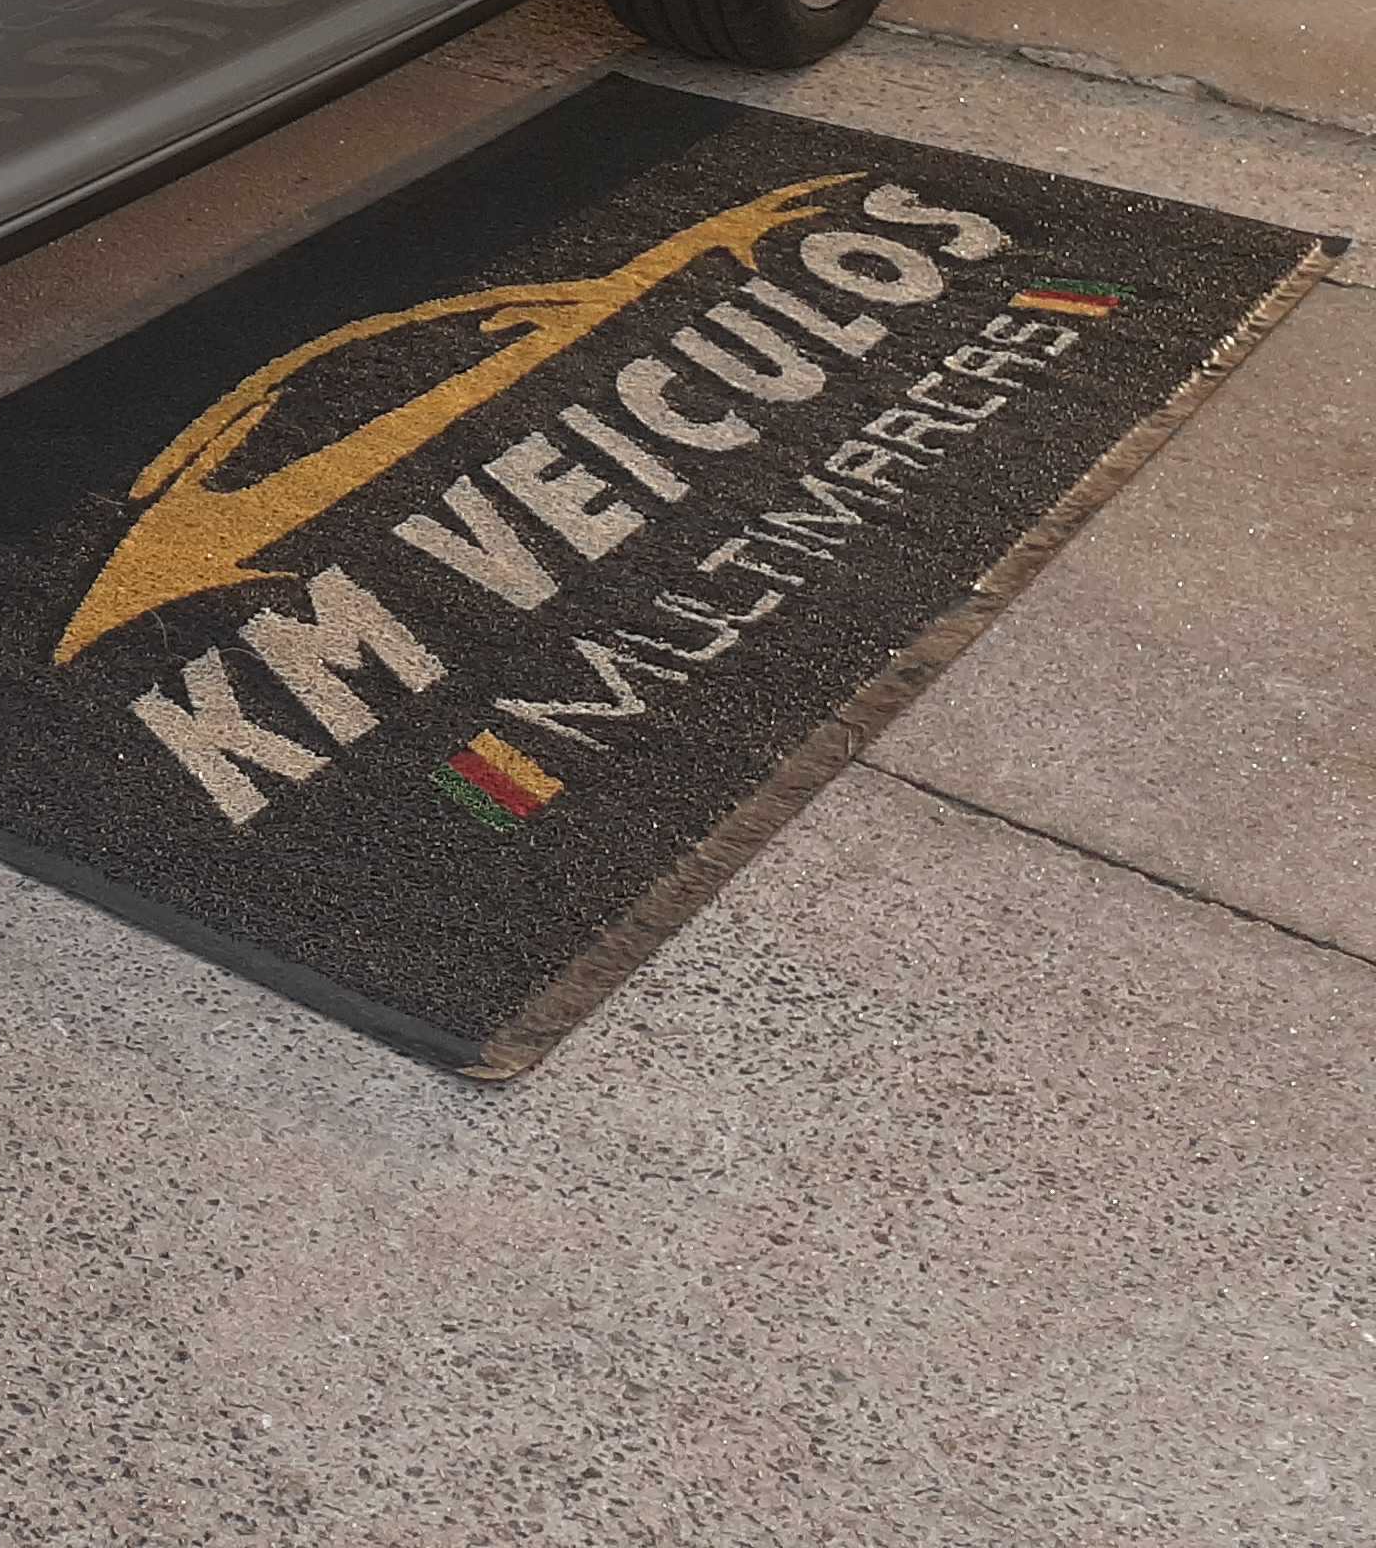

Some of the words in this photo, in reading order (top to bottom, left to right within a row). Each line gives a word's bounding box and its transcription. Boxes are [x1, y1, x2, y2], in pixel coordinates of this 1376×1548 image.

[130, 567, 447, 826] KM
[391, 184, 1014, 610] VEICULOS
[494, 313, 1082, 750] MULTIMARCAS
